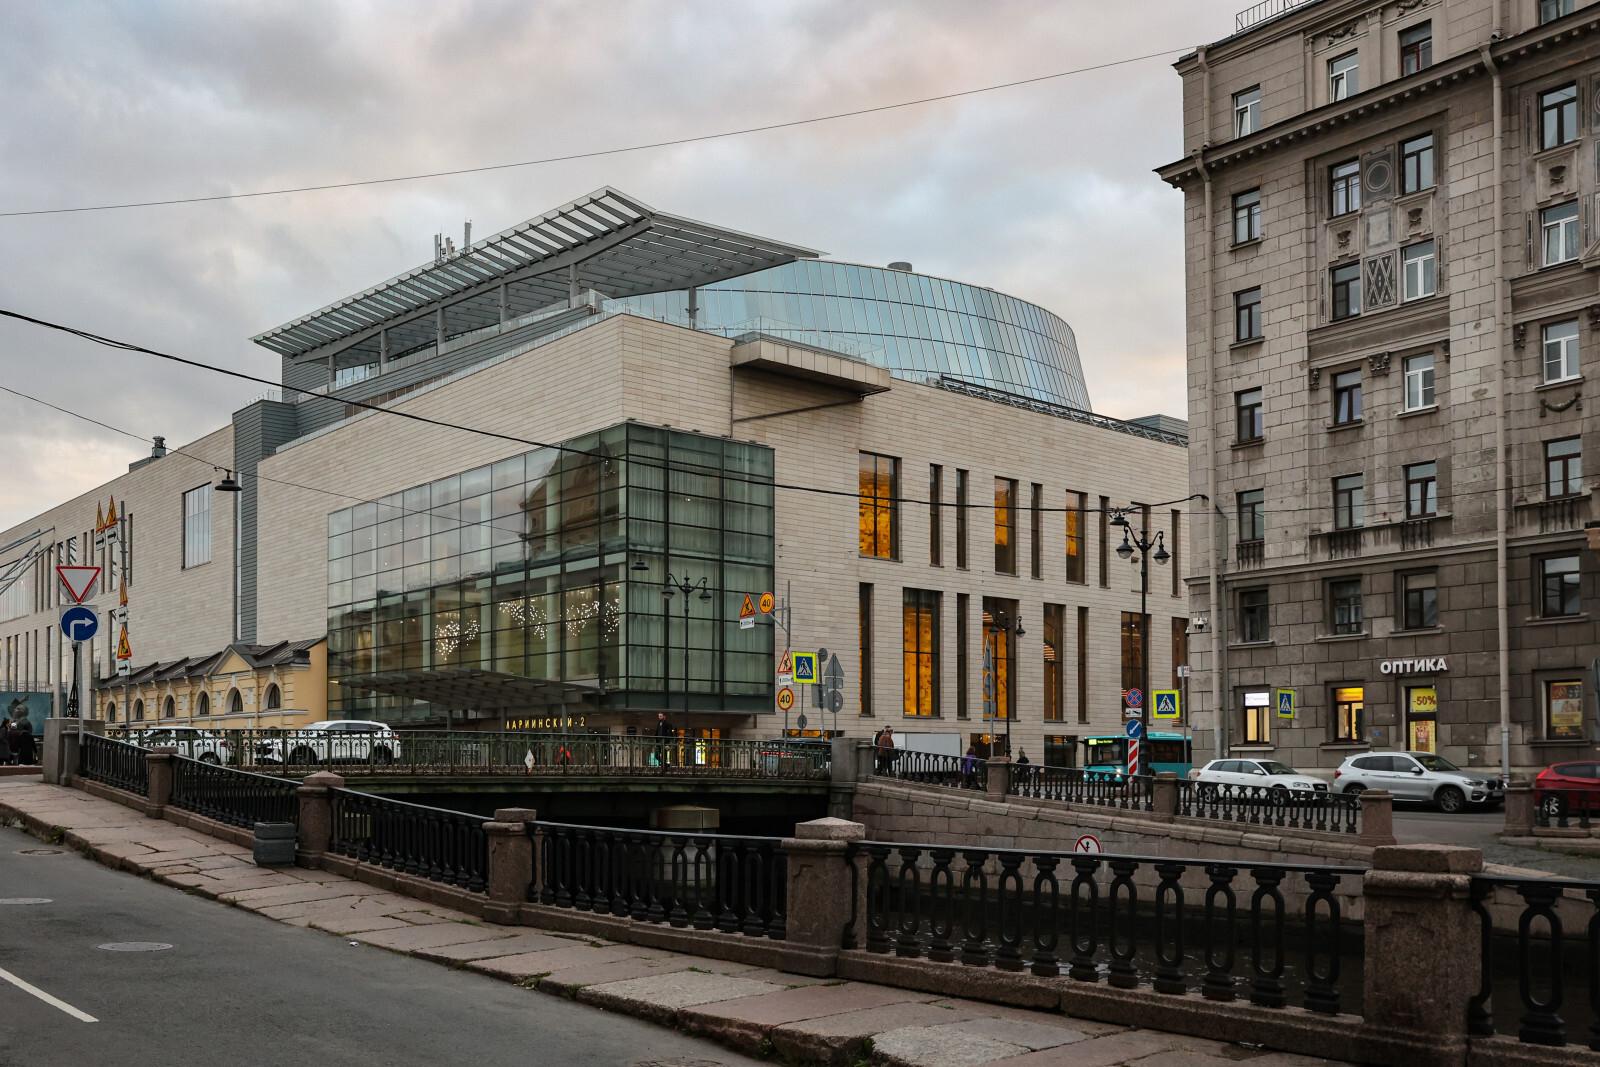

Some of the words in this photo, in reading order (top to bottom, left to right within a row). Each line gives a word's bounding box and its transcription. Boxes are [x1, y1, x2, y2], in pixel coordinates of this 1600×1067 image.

[762, 599, 771, 608] 40
[1380, 657, 1448, 674] ОПТИКА
[780, 695, 791, 704] 40
[1412, 696, 1438, 706] -50%
